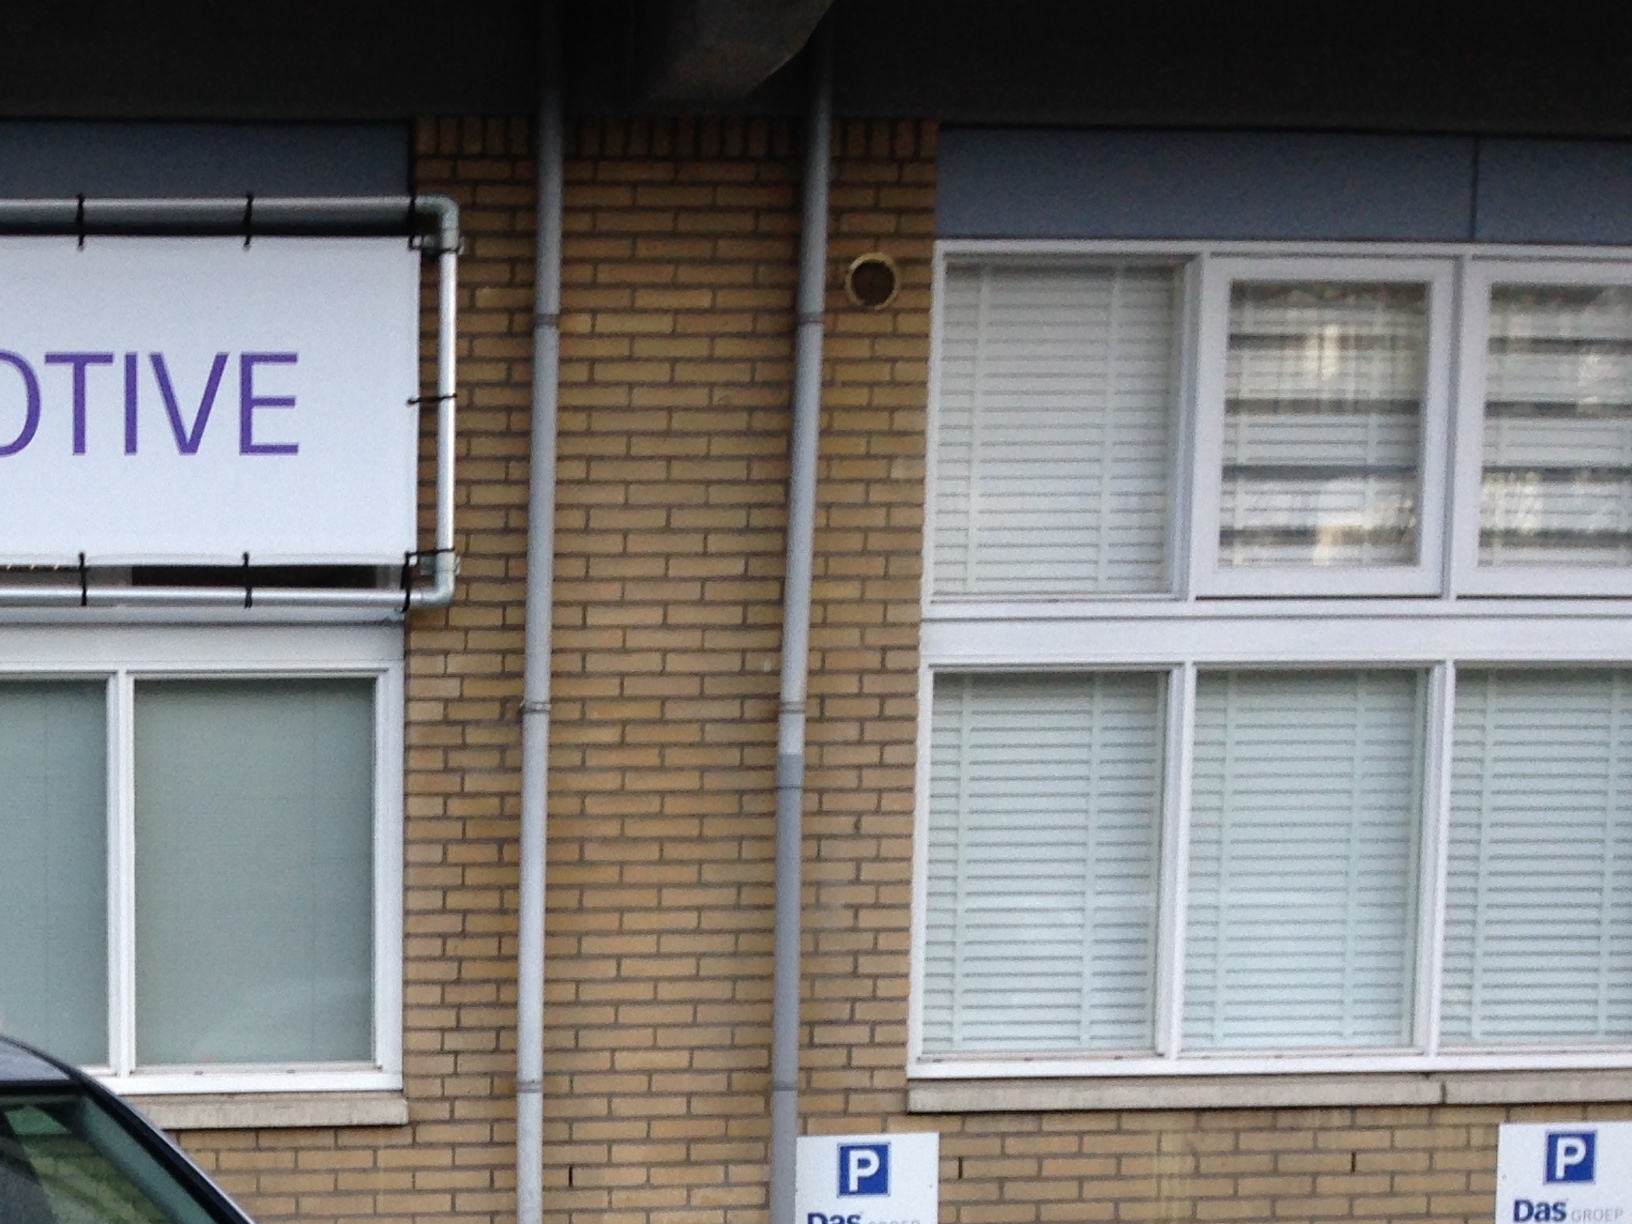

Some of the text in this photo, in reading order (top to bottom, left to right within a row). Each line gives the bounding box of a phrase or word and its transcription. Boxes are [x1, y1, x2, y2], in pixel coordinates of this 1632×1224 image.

[848, 1149, 880, 1193] P
[1555, 1137, 1587, 1179] P
[1513, 1199, 1567, 1223] Das
